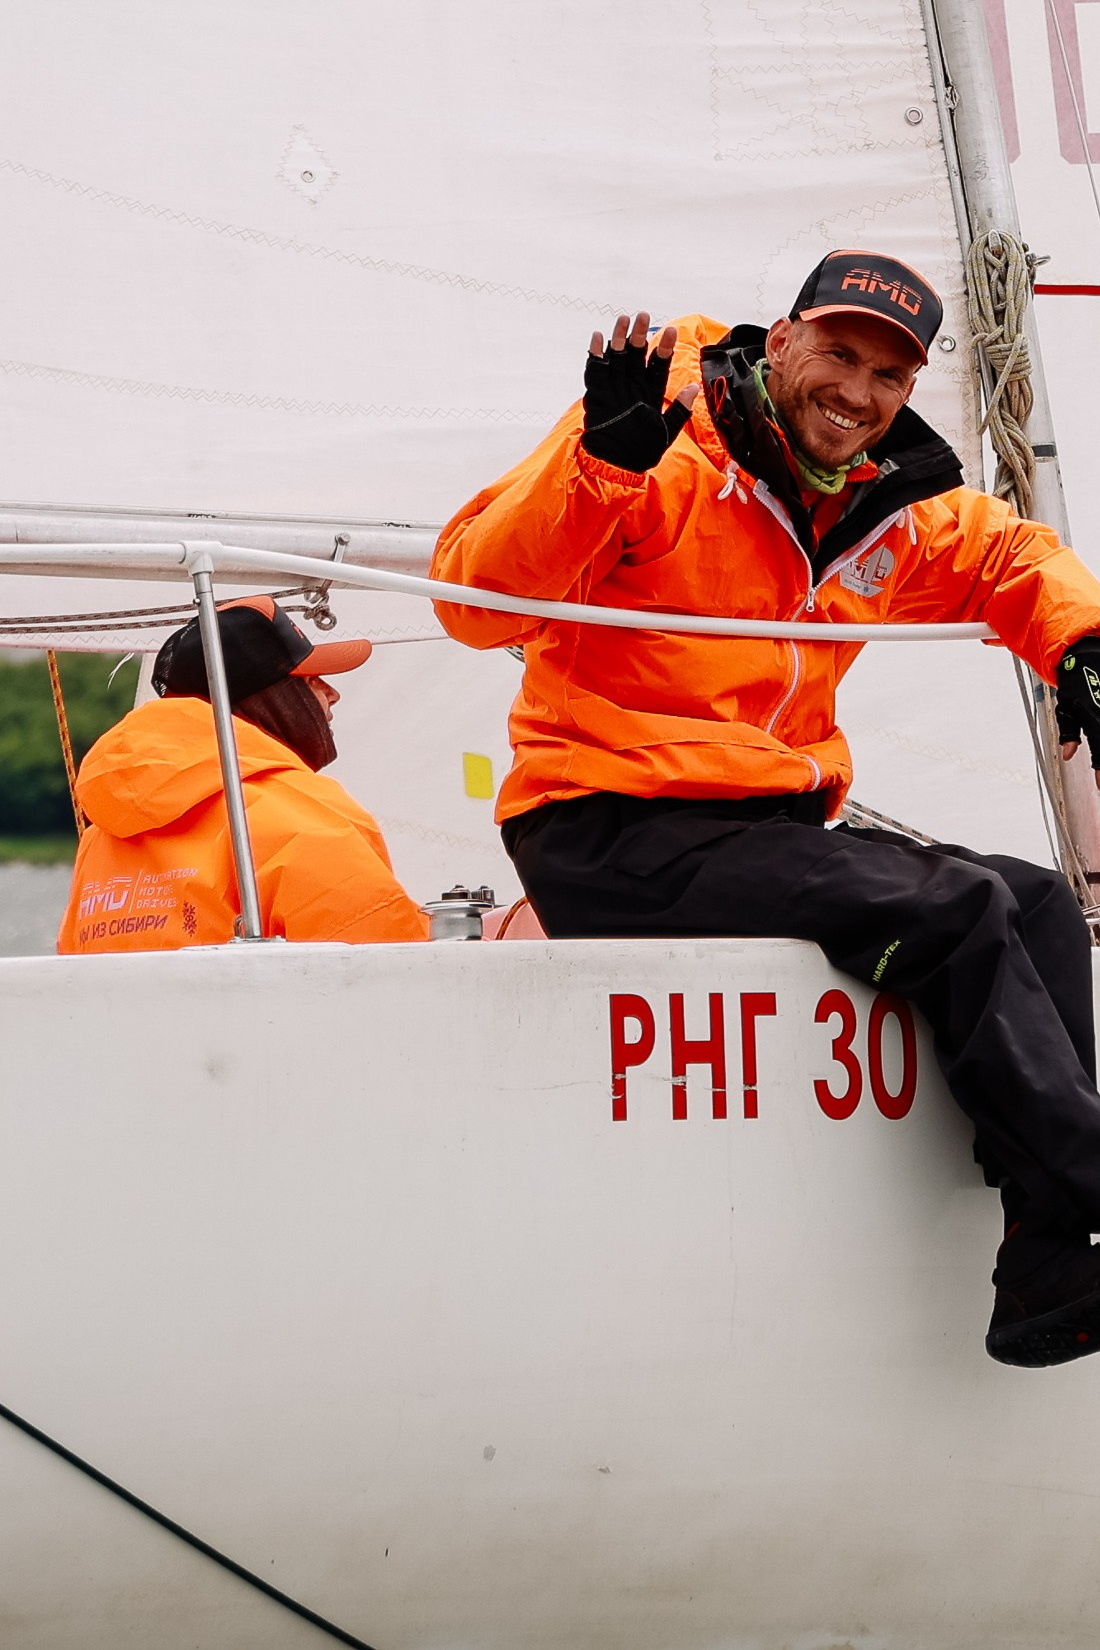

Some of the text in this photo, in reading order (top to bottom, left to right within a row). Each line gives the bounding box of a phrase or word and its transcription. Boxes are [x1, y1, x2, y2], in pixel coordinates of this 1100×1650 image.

[92, 921, 107, 940] ИЗ
[108, 914, 168, 936] СИБИРИ
[609, 989, 918, 1121] РНГ 30
